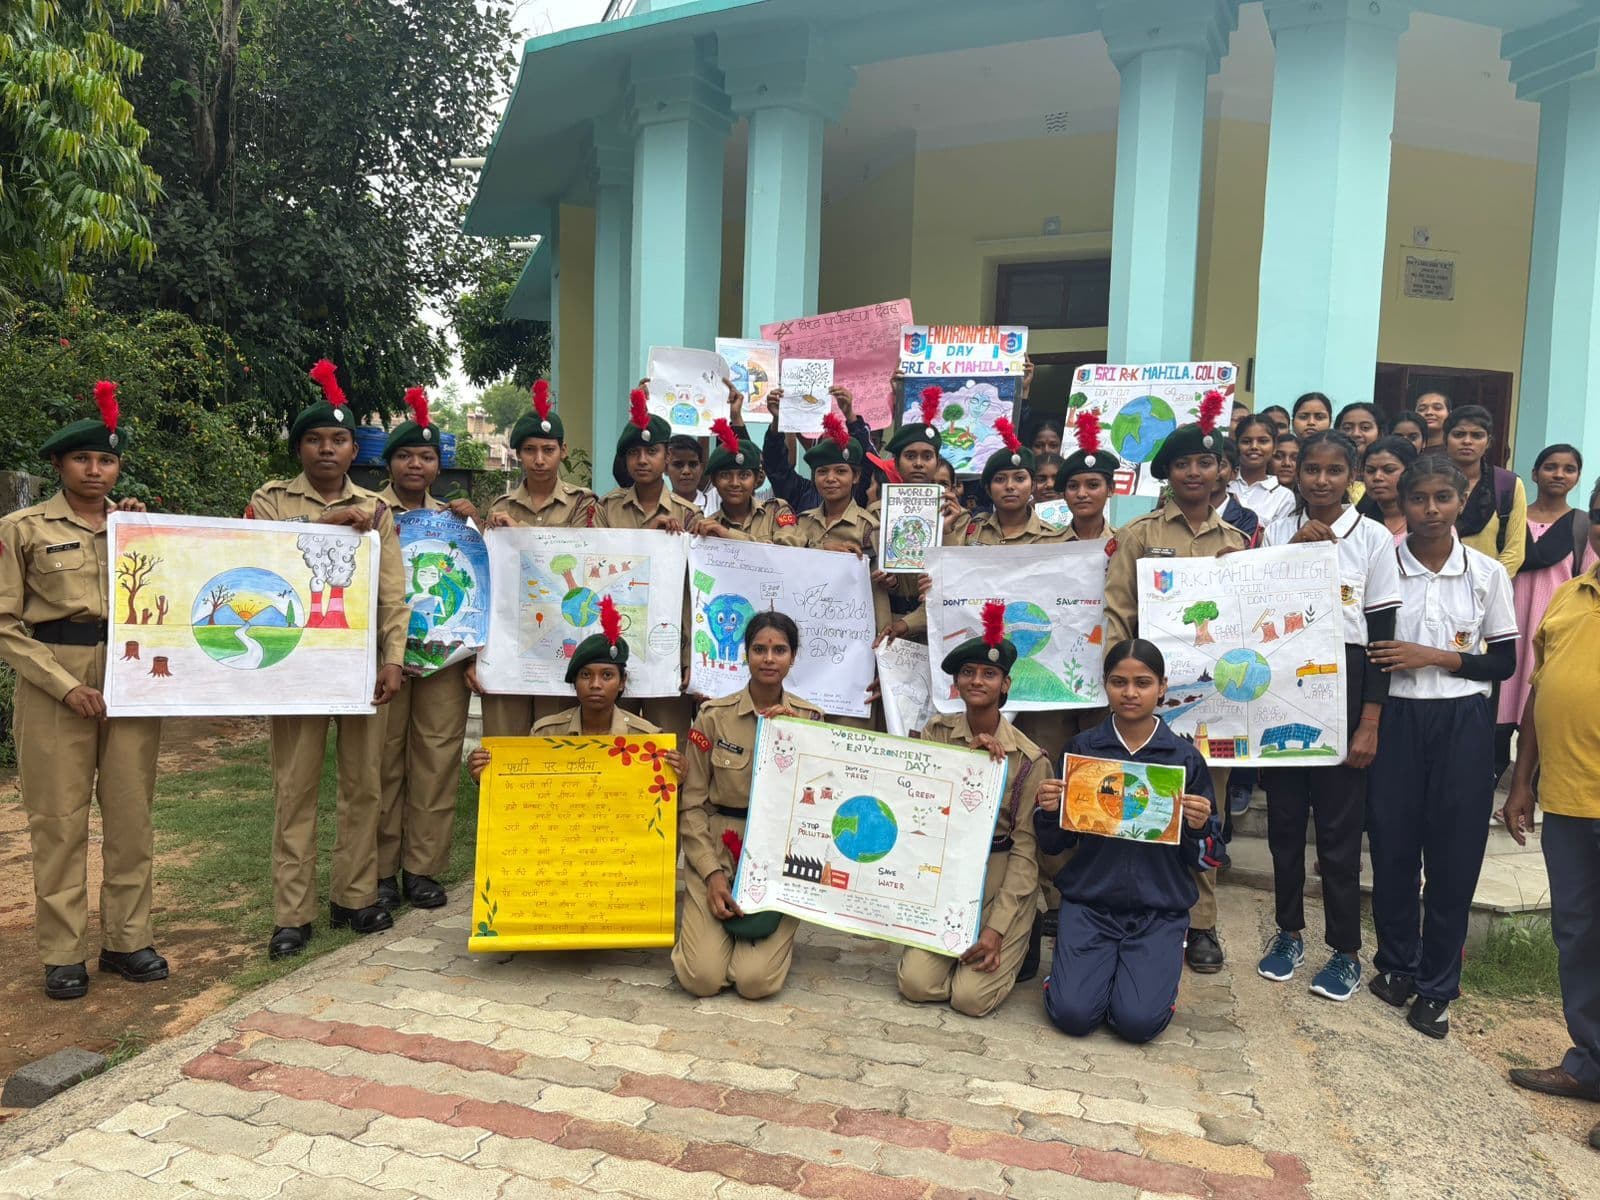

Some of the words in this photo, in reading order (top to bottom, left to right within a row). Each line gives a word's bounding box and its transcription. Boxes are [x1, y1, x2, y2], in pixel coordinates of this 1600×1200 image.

[946, 345, 973, 356] DAY
[901, 361, 924, 374] SRI
[1094, 366, 1116, 381] SRI
[691, 731, 709, 748] NCC
[831, 729, 866, 741] WORLD
[846, 743, 932, 761] ENVIRONMENT
[905, 760, 931, 774] DAY
[897, 776, 911, 788] GO
[908, 788, 936, 799] GREEN
[802, 822, 820, 830] STOP
[878, 867, 897, 877] SAVE
[879, 879, 905, 890] WATER
